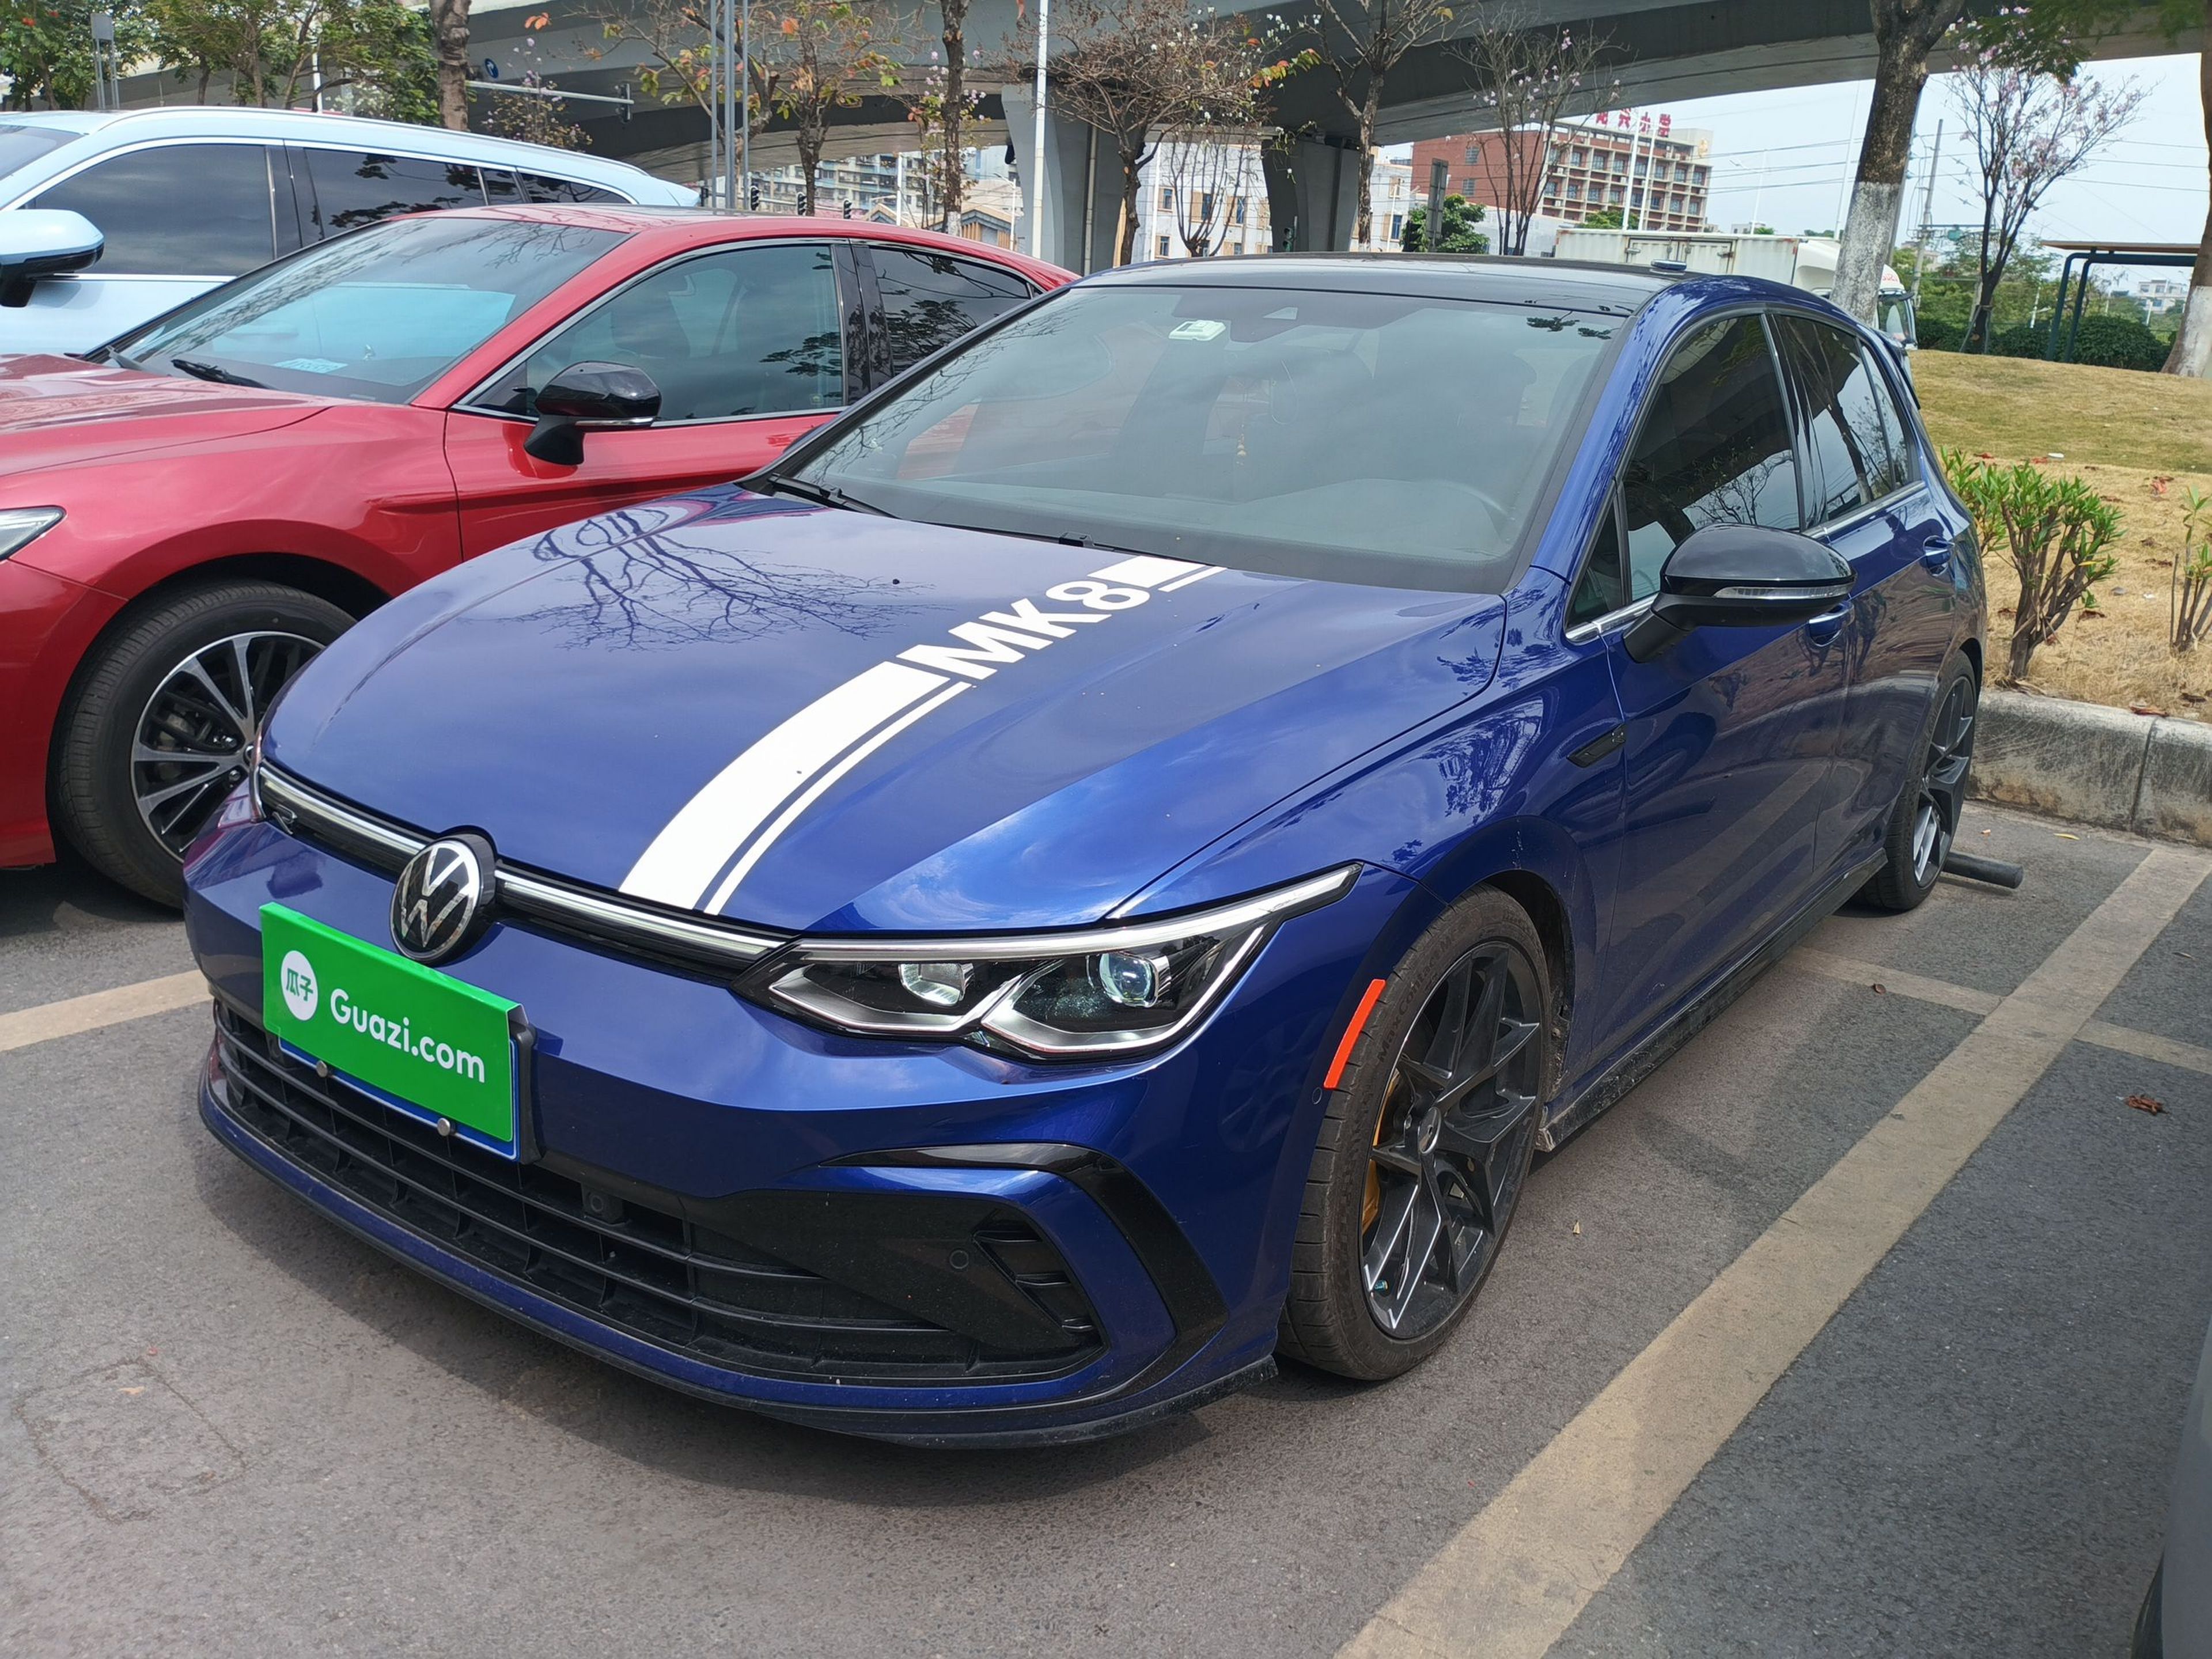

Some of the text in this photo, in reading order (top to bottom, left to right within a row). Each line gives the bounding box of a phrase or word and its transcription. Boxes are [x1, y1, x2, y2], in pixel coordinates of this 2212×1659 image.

[896, 580, 1150, 680] MK8
[286, 968, 313, 1002] 瓜子
[329, 988, 485, 1083] Guazi.com
